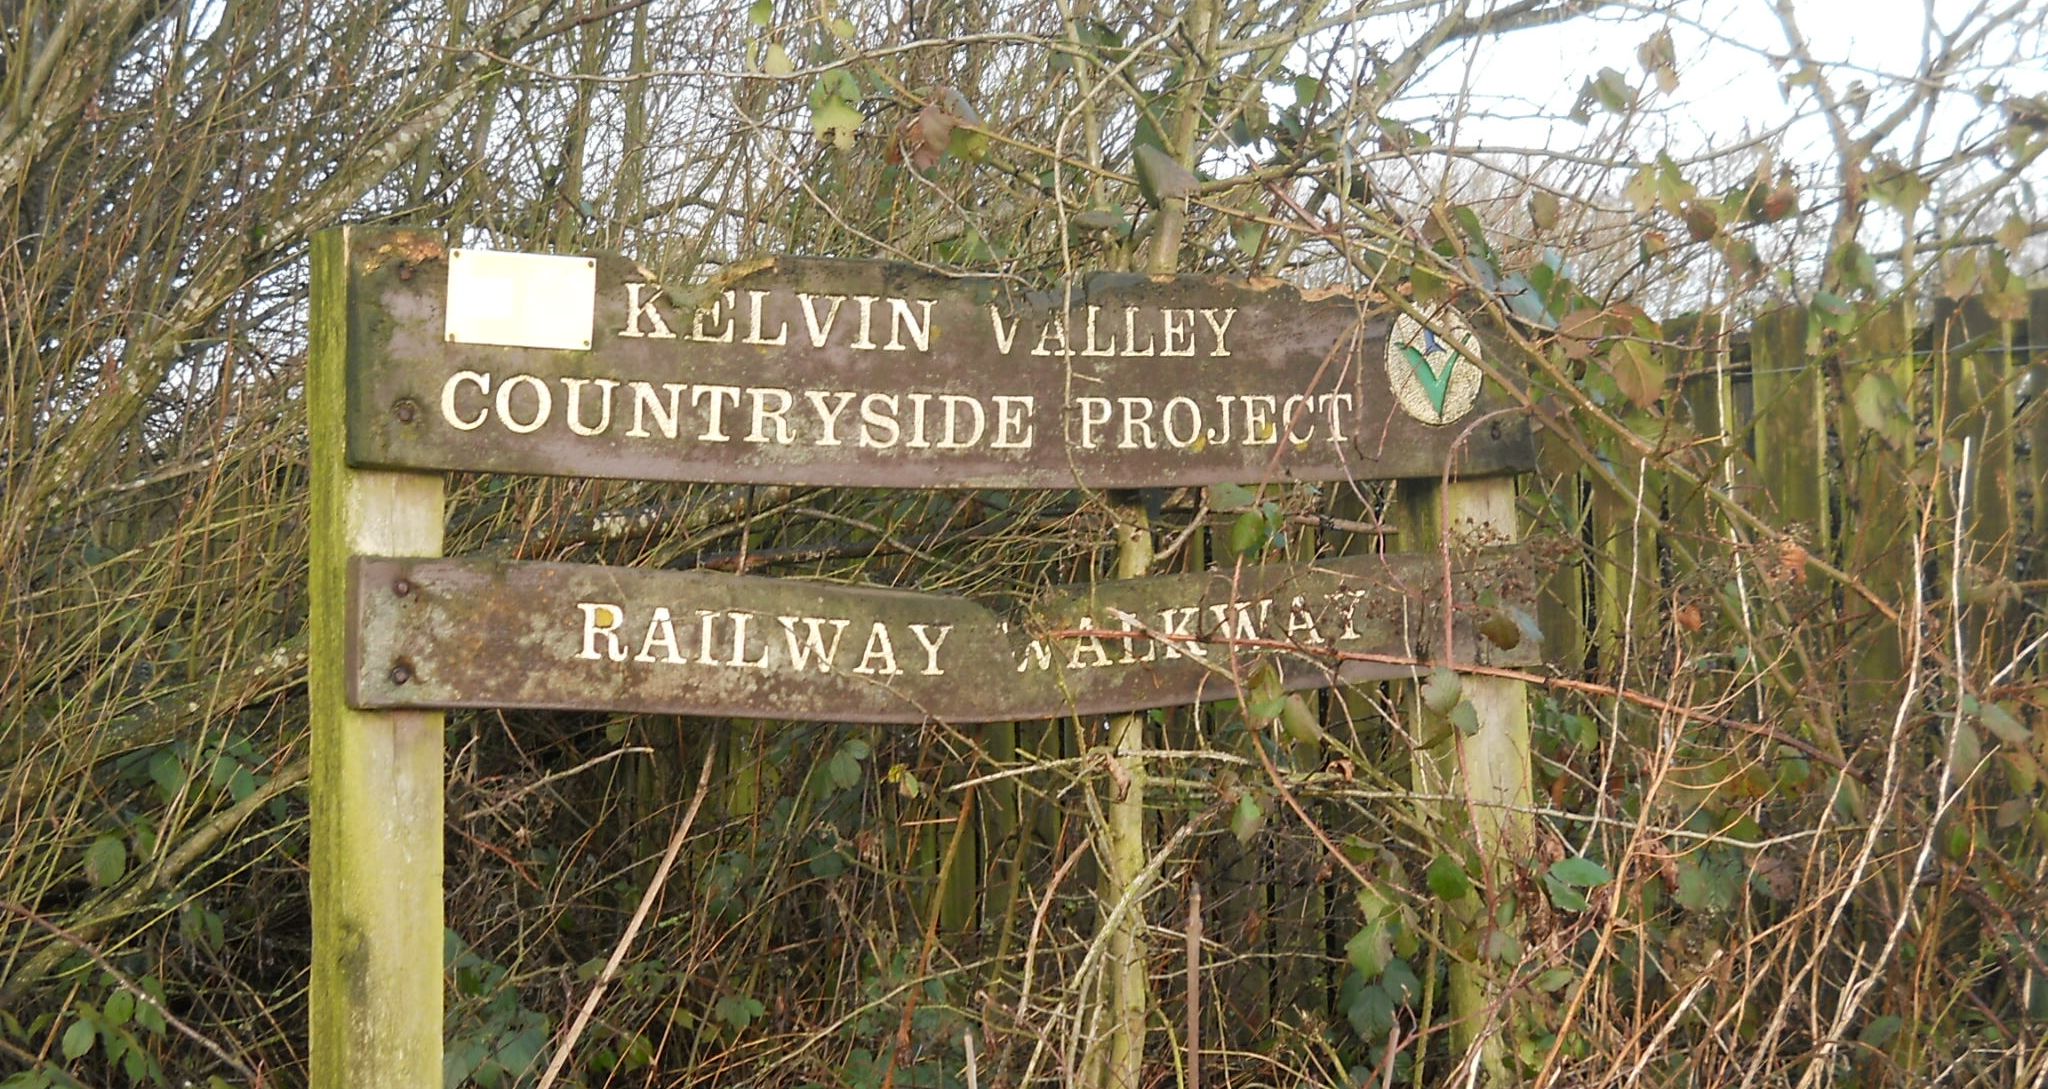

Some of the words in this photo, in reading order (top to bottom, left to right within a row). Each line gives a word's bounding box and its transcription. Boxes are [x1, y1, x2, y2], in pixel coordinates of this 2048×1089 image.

[618, 282, 937, 352] KELVIN
[987, 304, 1237, 357] VALLEY
[440, 370, 1034, 450] COUNTRYSIDE
[1076, 393, 1352, 450] PROJECT
[574, 602, 954, 676] RAILWAY
